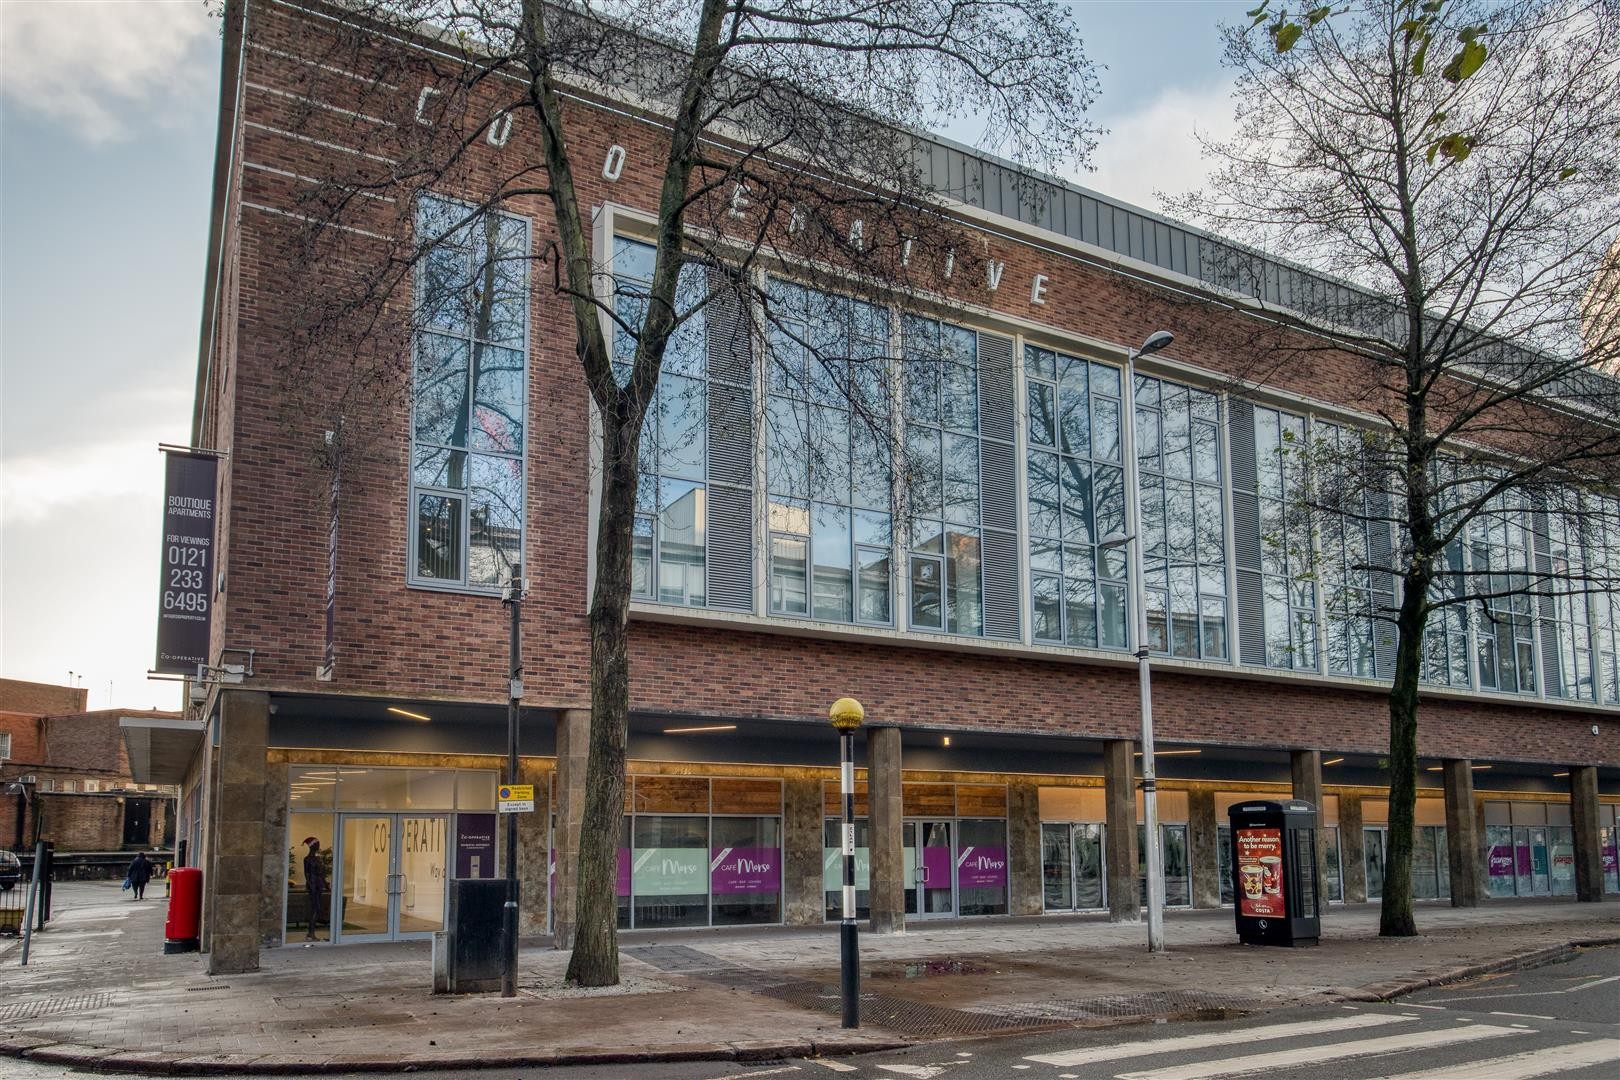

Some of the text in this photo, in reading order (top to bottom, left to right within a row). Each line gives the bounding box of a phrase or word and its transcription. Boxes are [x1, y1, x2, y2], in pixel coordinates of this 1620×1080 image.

[168, 495, 212, 511] BOUTIQUE
[168, 507, 212, 519] APARTMENTS
[166, 534, 210, 547] FOR VIEWINGS
[168, 545, 206, 567] 0121
[170, 568, 203, 589] 233
[163, 590, 208, 612] 6495
[1238, 835, 1261, 843] Another
[662, 858, 697, 875] Morso
[737, 858, 771, 875] Morso
[978, 855, 1005, 871] Morso
